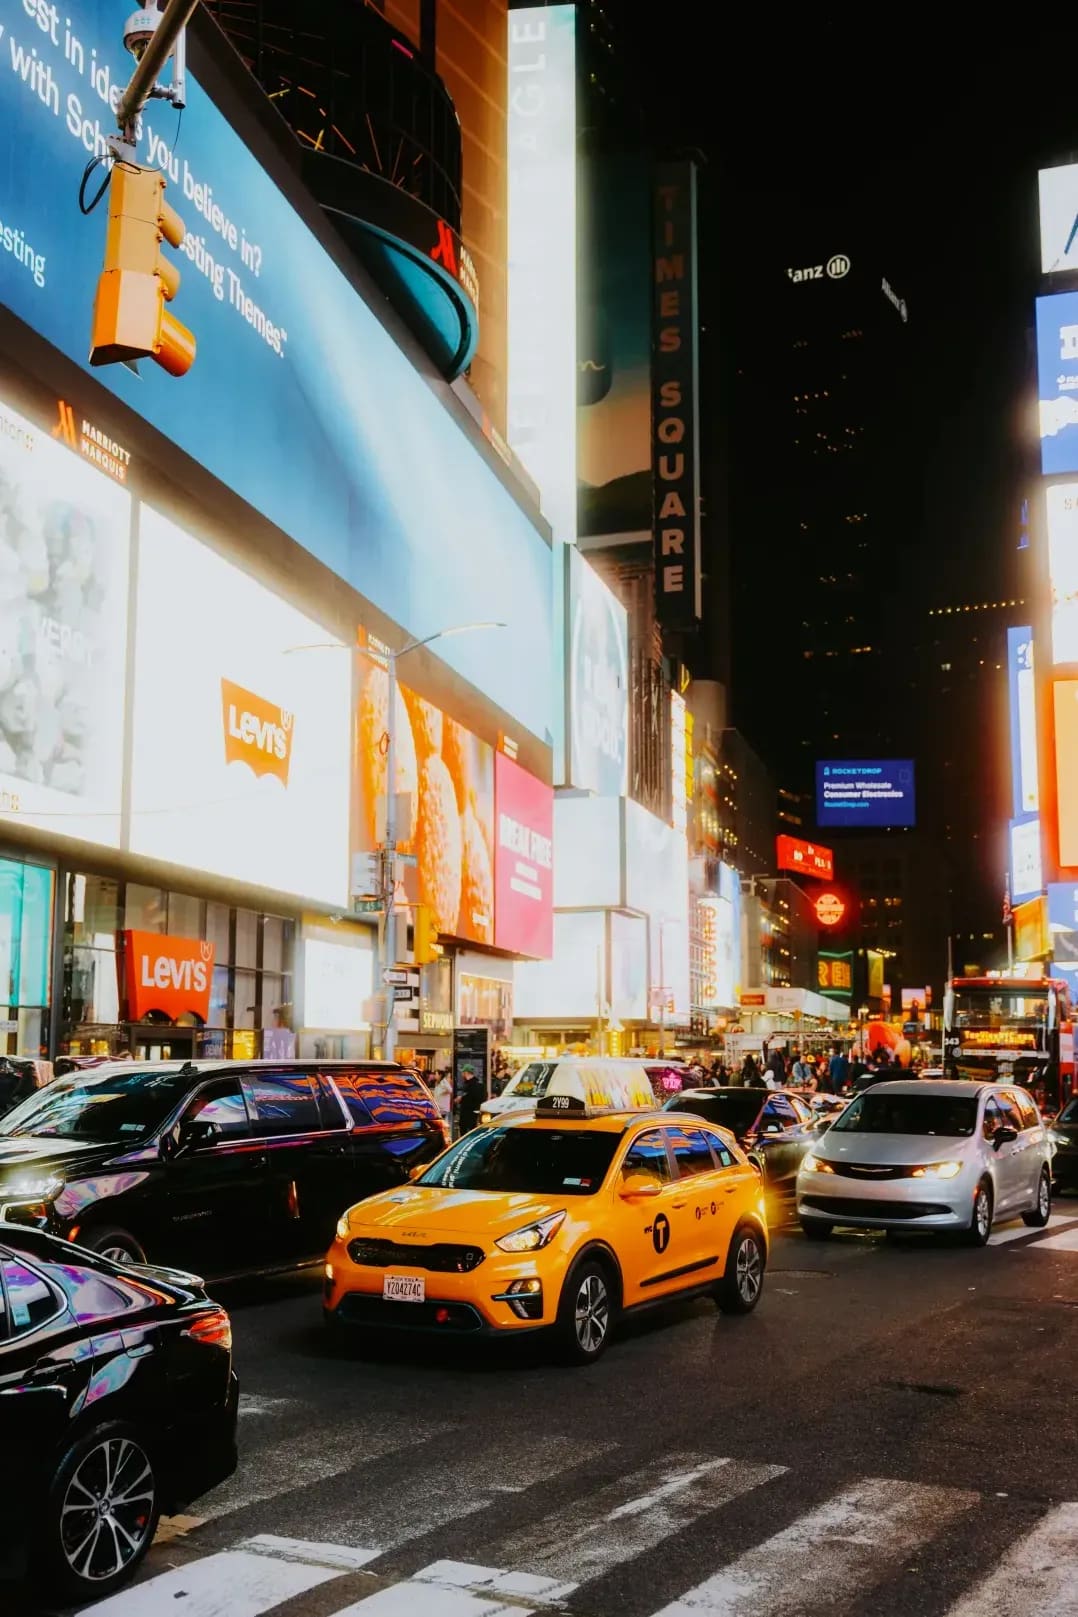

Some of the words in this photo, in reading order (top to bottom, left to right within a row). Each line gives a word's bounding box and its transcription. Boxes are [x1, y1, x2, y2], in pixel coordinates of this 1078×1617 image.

[10, 37, 59, 116] with
[65, 18, 83, 74] in
[147, 126, 179, 184] you
[183, 159, 238, 250] believe
[241, 229, 262, 278] in?
[656, 186, 685, 353] TIMES
[81, 438, 125, 480] MARQUIS
[82, 419, 131, 465] MARRIOTT
[658, 380, 686, 594] SQUARE
[552, 1096, 570, 1109] 2Y99
